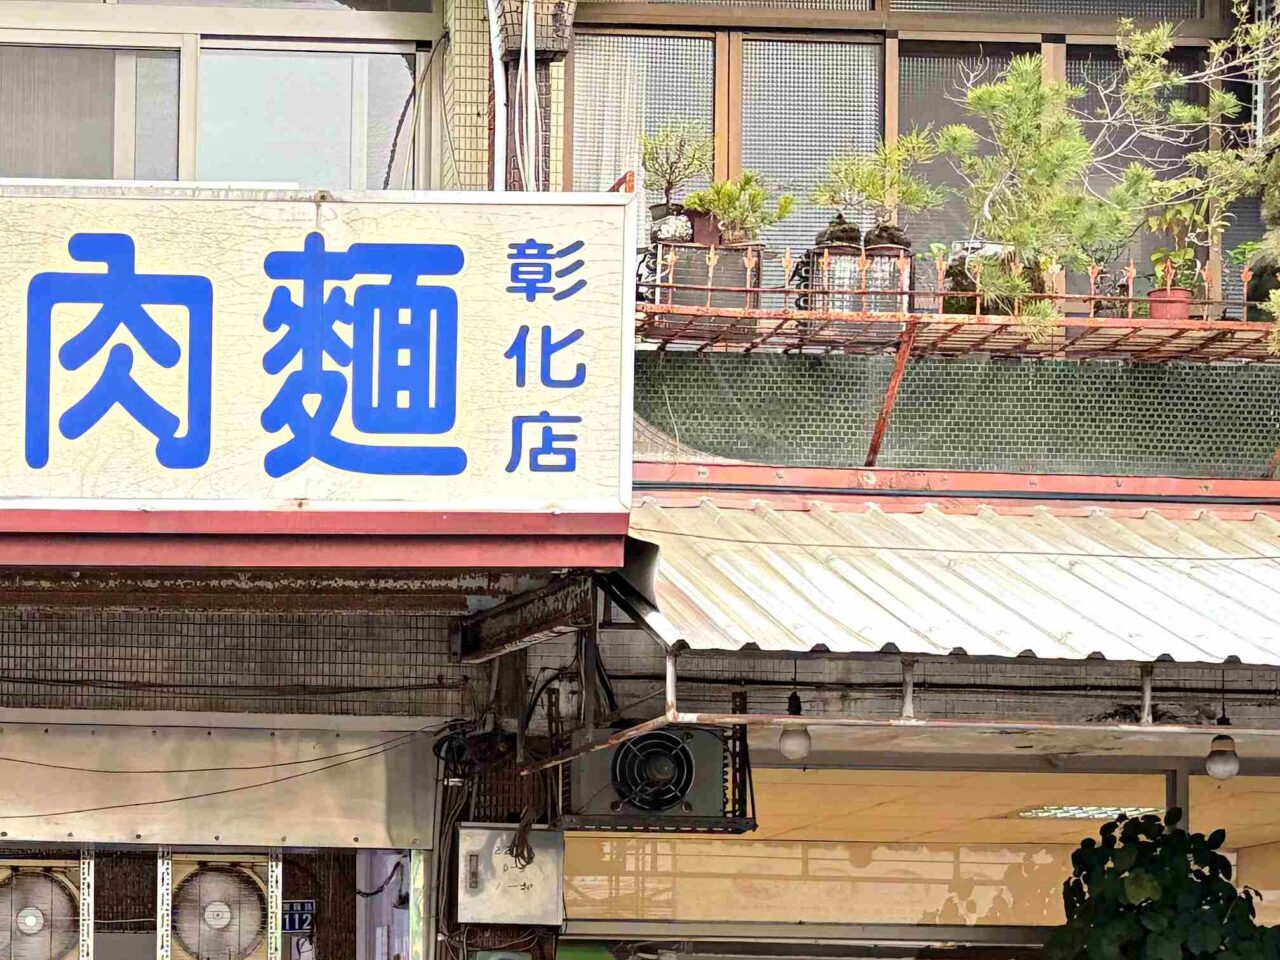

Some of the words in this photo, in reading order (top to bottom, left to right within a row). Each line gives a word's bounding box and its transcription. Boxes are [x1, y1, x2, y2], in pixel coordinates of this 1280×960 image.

[504, 238, 587, 474] 彰化店
[283, 913, 312, 930] 112
